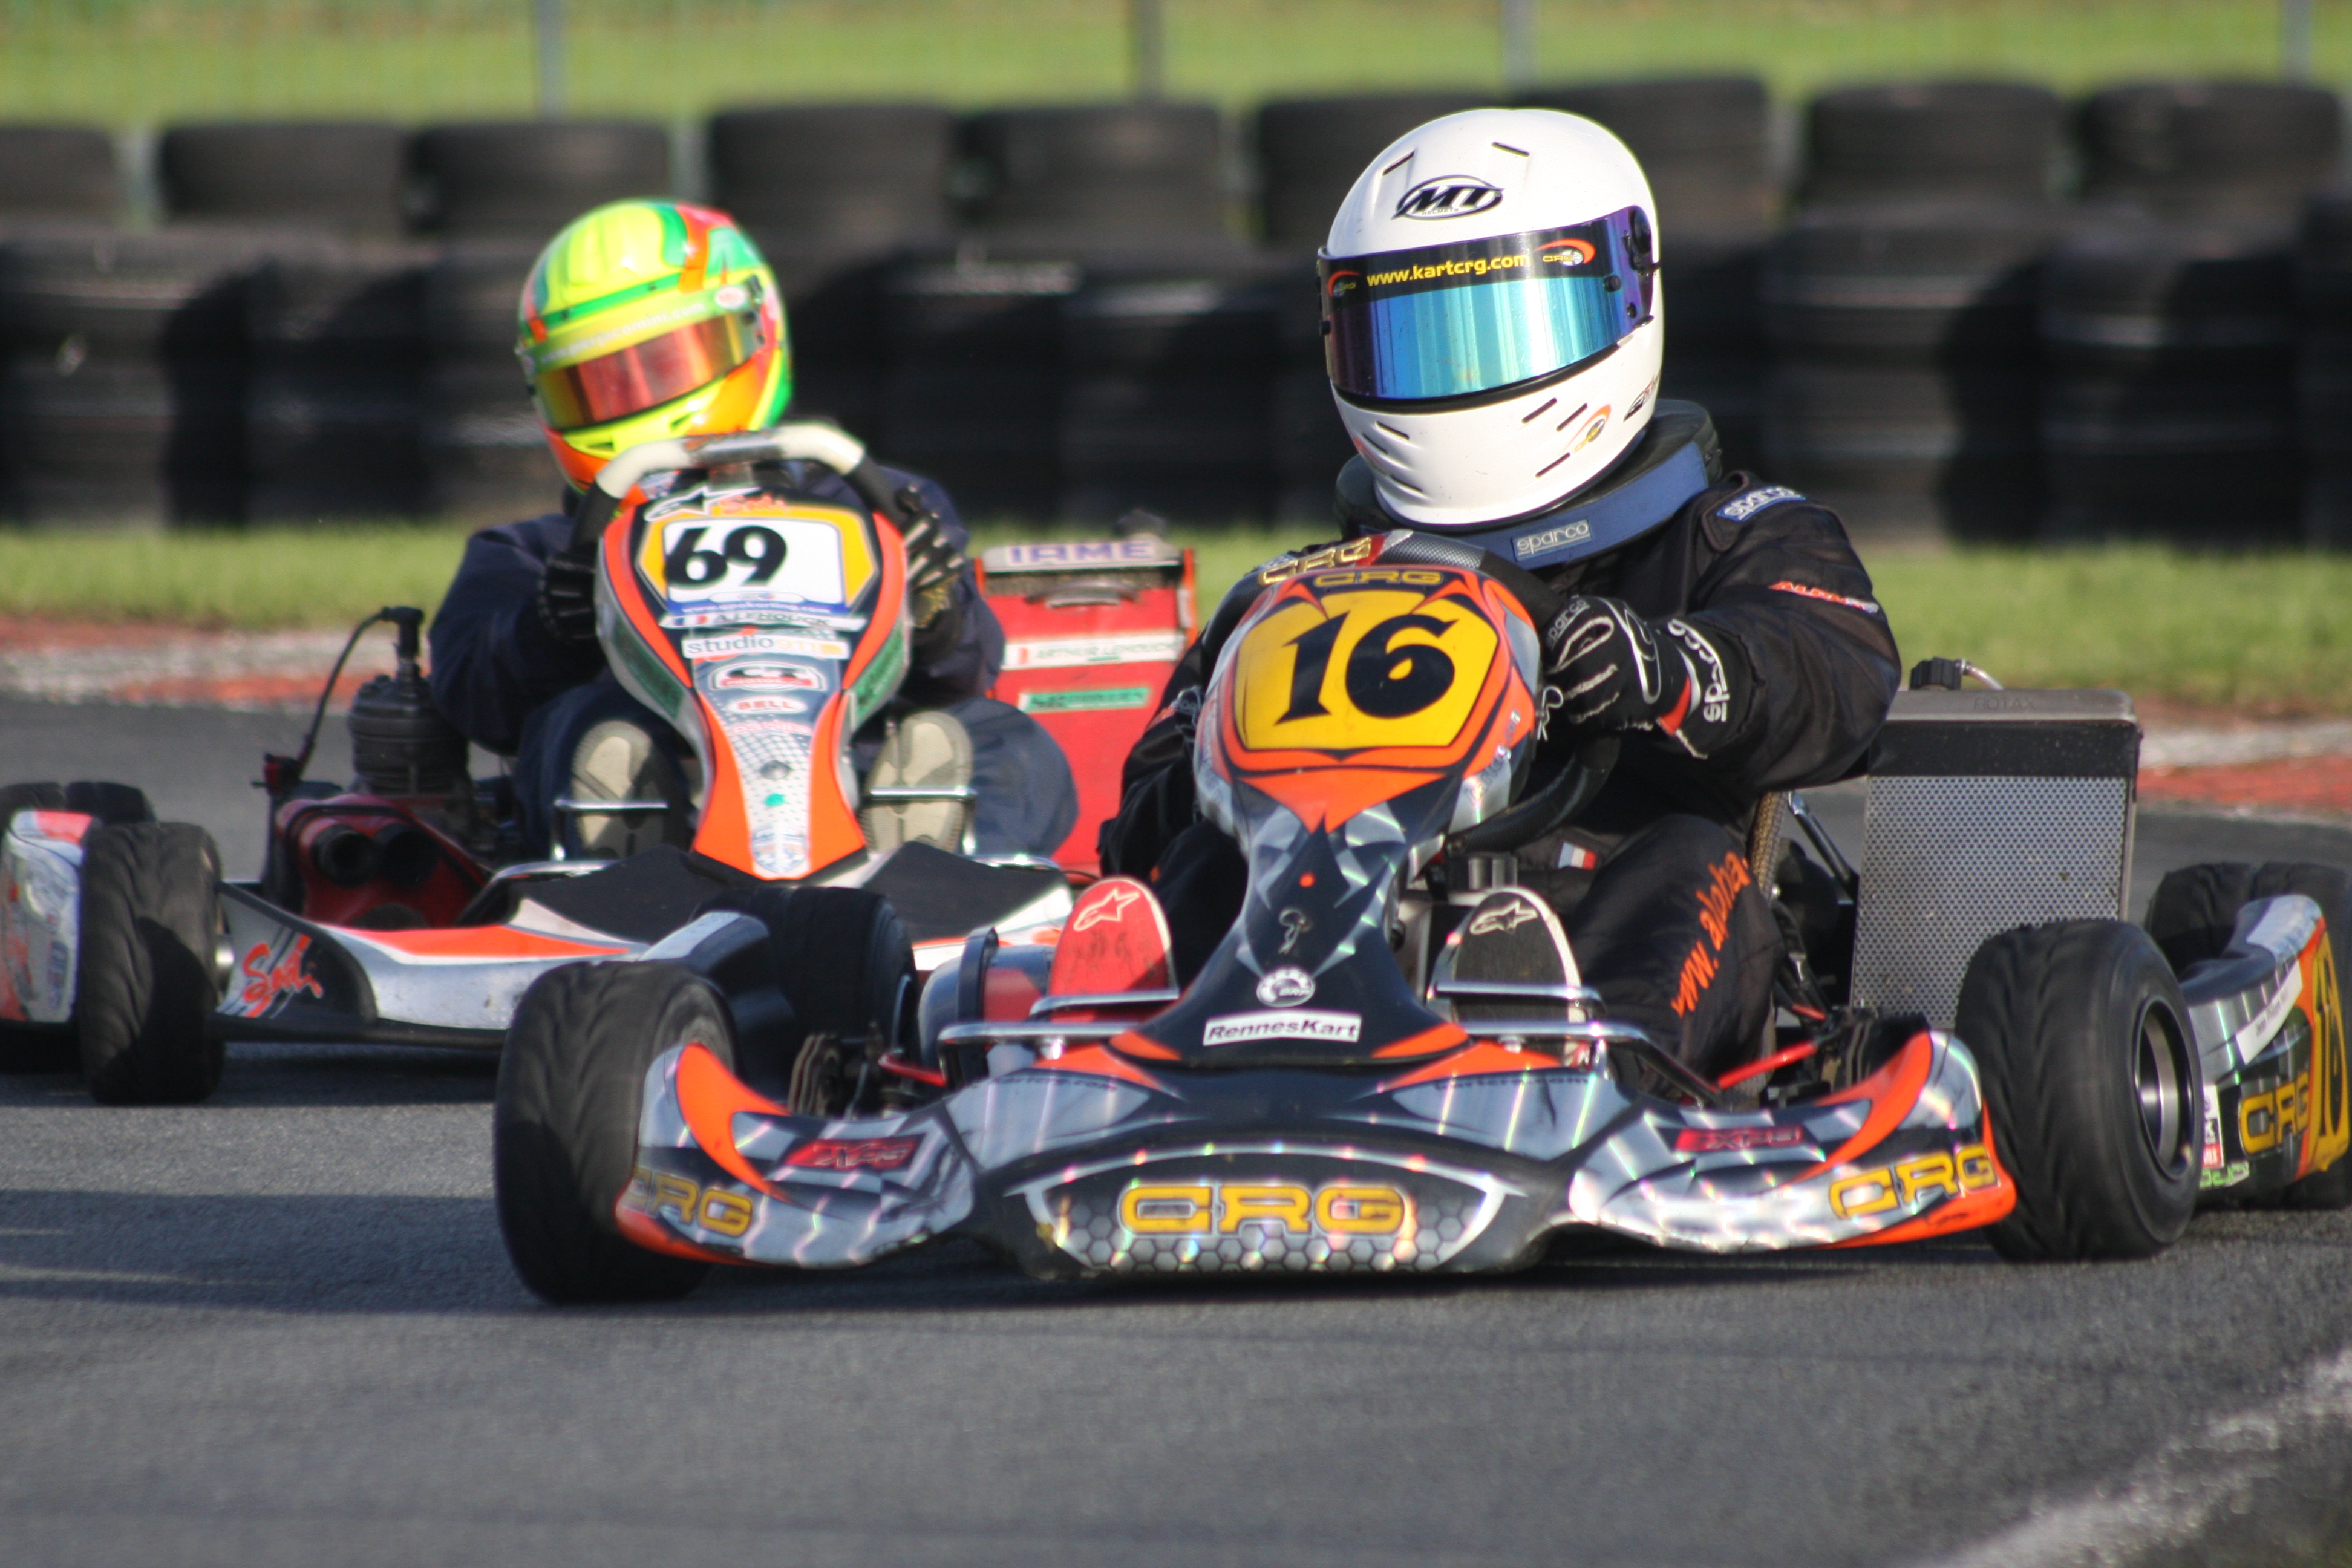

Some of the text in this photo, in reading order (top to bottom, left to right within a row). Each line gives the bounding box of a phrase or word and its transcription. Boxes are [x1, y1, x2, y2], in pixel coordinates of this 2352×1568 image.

[1367, 253, 1530, 287] www.kartcrg.com
[1517, 521, 1588, 553] sparco
[666, 525, 787, 587] 69
[1011, 546, 1151, 563] IAME
[1313, 571, 1444, 586] CRG
[1275, 610, 1459, 724] 16
[738, 701, 795, 710] BELL
[1209, 1018, 1357, 1042] RennesKart
[2239, 1071, 2310, 1154] CRG
[1828, 1142, 1996, 1220] CRG
[1119, 1184, 1408, 1235] CRG
